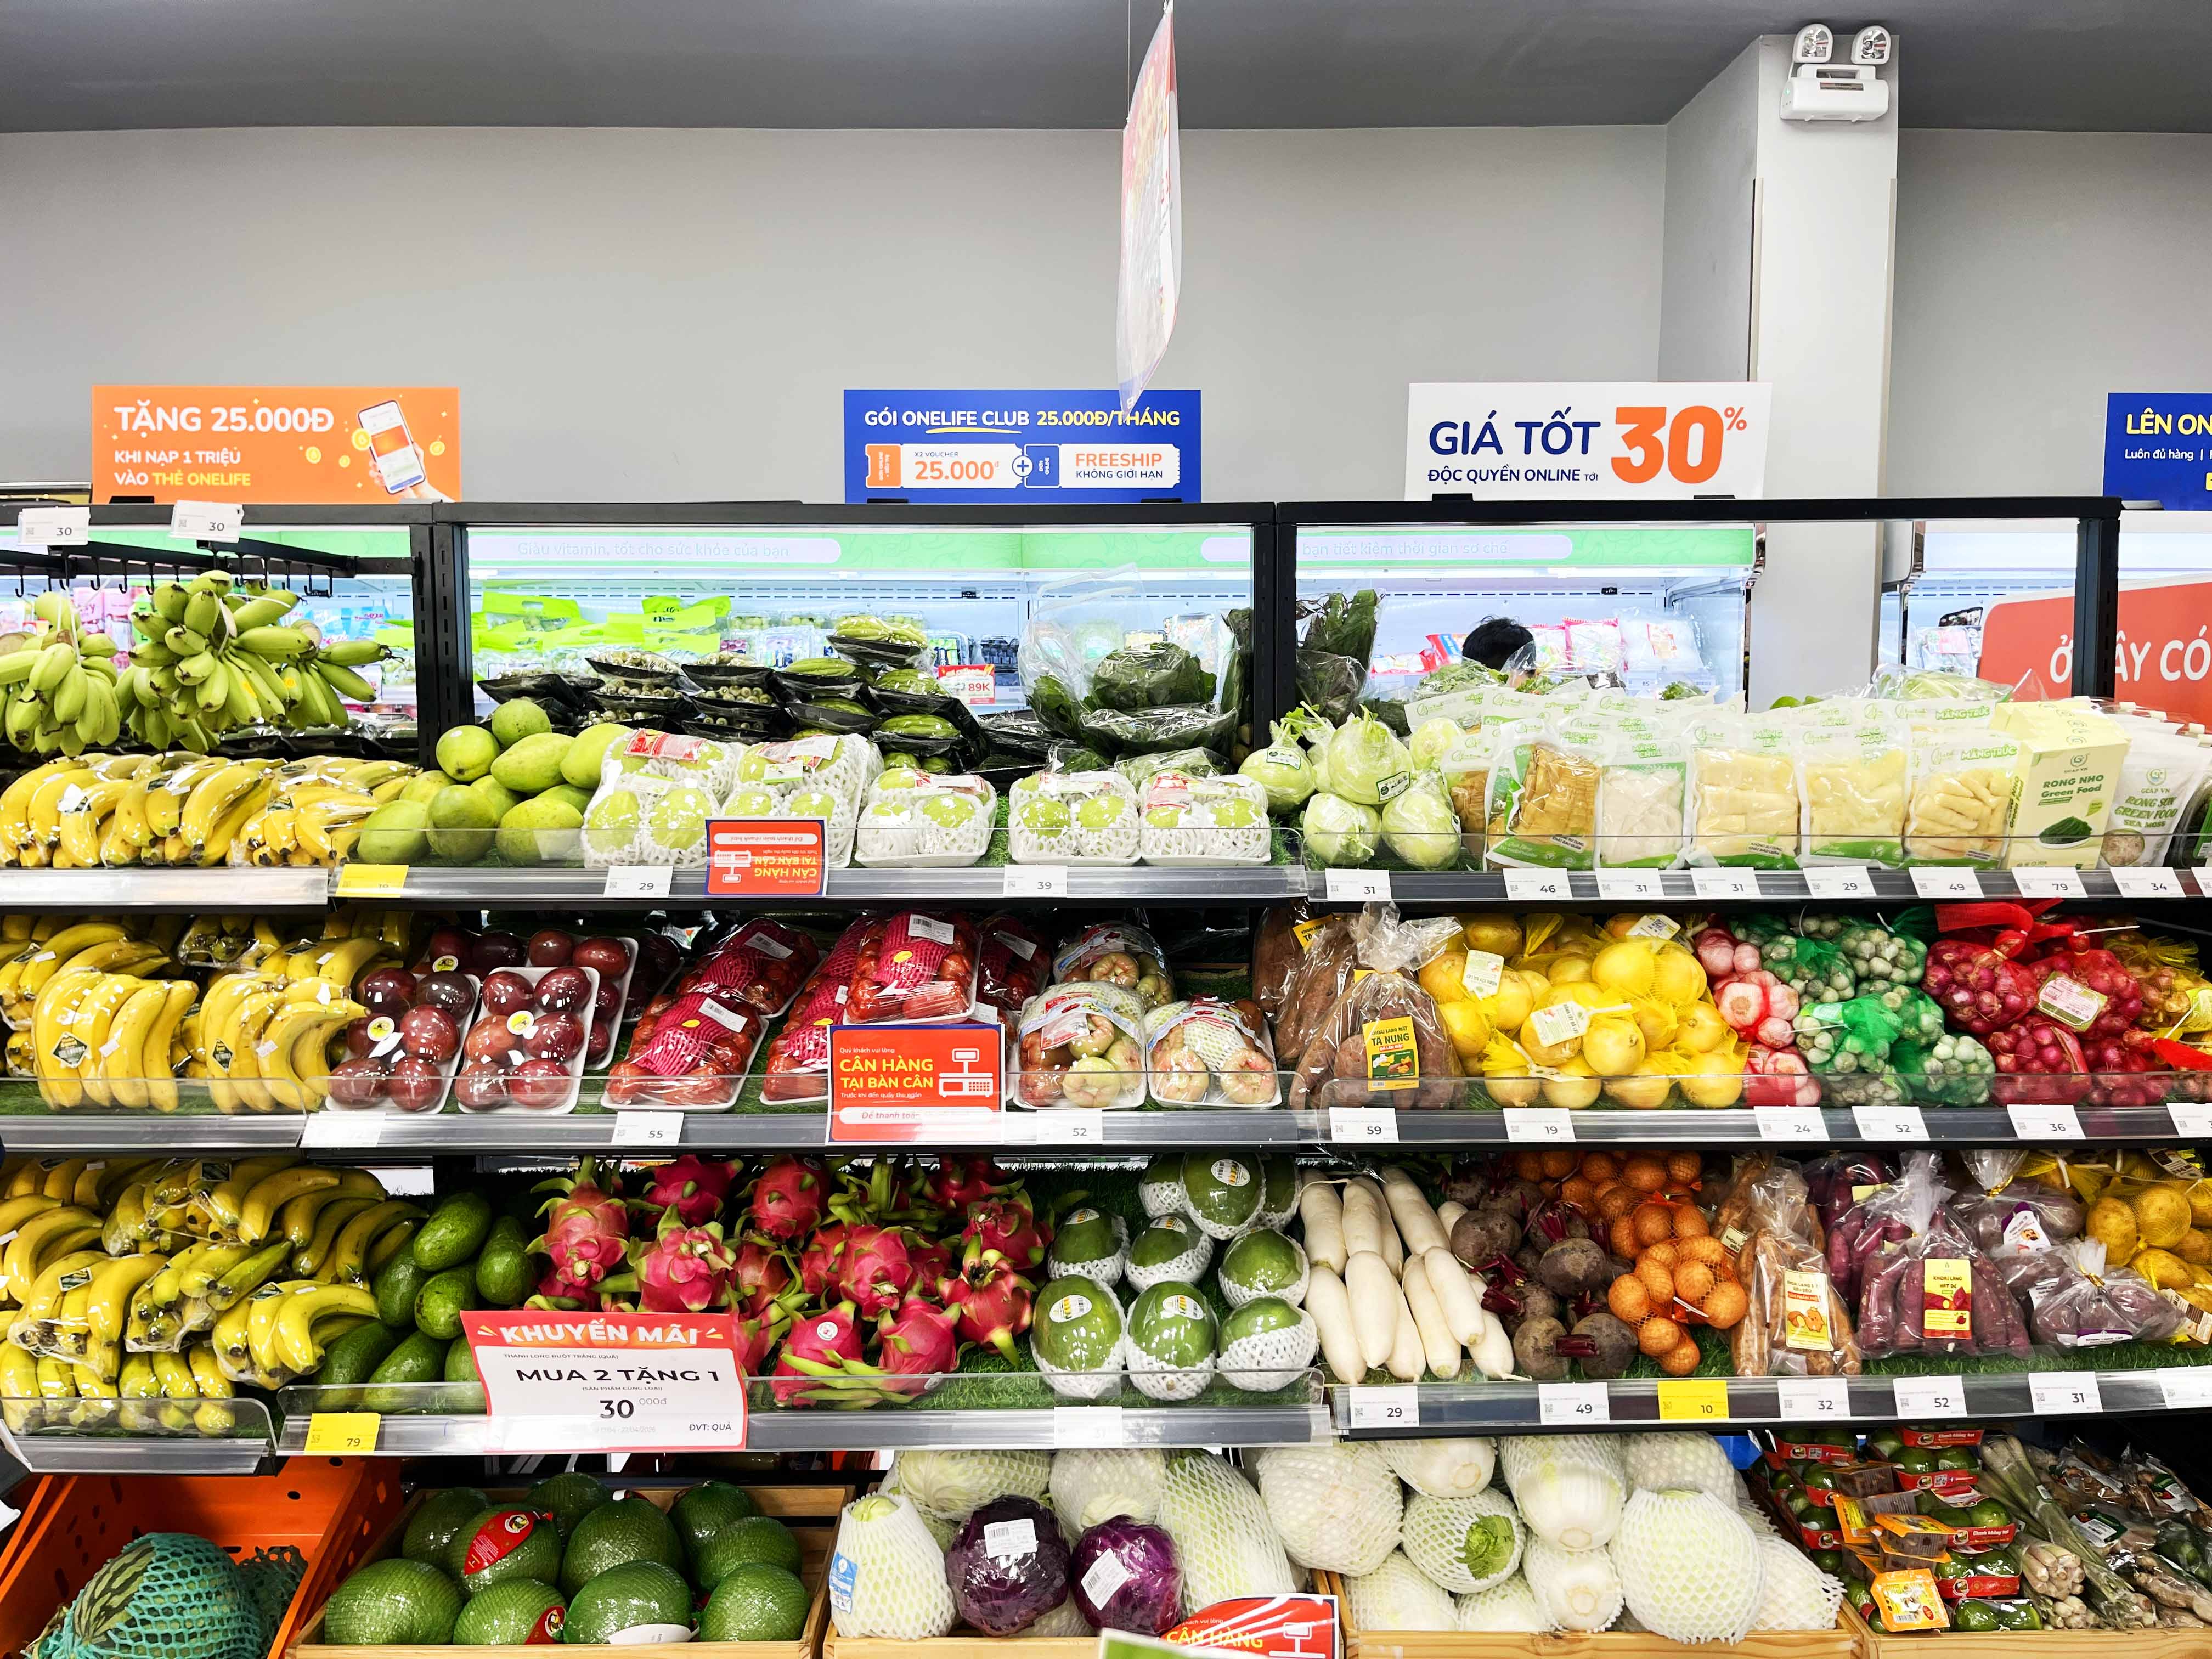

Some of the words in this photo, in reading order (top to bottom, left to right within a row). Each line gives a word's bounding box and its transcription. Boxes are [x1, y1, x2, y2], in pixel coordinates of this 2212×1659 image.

[114, 399, 201, 438] TẶNG
[211, 408, 334, 432] 25.000Đ
[865, 407, 898, 426] GÓI
[902, 410, 977, 427] ONELIFE
[982, 410, 1030, 426] CLUB
[2126, 408, 2172, 435] LÊN
[2177, 413, 2212, 435] ON
[1429, 410, 1503, 455] GIÁ
[1514, 406, 1601, 455] TỐT
[114, 450, 141, 464] KHI
[145, 450, 179, 466] NẠP
[183, 450, 192, 464] 1
[195, 447, 241, 465] TRIỆU
[2125, 449, 2151, 460] Luôn
[2153, 448, 2166, 460] đủ
[2168, 448, 2194, 461] hàng
[1075, 453, 1163, 468] FREESHIP
[114, 469, 149, 486] VÀO
[152, 469, 184, 486] THẺ
[187, 472, 251, 486] ONELIFE
[1076, 468, 1114, 479] KHÔNG
[1117, 468, 1146, 479] GIỚI
[1148, 470, 1164, 482] HẠN
[1427, 465, 1463, 485] ĐỘC
[1466, 464, 1520, 483] QUYỀN
[1524, 469, 1581, 482] ONLINE
[1584, 471, 1599, 482] TỚI
[57, 527, 72, 537] 30
[209, 522, 225, 532] 30
[517, 543, 549, 556] Giàu
[637, 543, 663, 555] cho
[668, 542, 691, 556] sức
[1360, 542, 1392, 557] kiệm
[1429, 543, 1458, 557] gian
[2115, 629, 2151, 683] ÂY
[2159, 625, 2212, 682] CÓ
[968, 682, 990, 692] 89K
[2043, 778, 2076, 789] RONG
[2079, 774, 2104, 785] NHO
[2041, 789, 2074, 799] Green
[2076, 783, 2103, 794] Food
[2155, 808, 2178, 819] FOOD
[777, 856, 799, 867] BÀN
[802, 855, 817, 865] TẠI
[754, 868, 789, 879] HÀNG
[792, 868, 817, 879] CÂN
[639, 882, 654, 891] 29
[1037, 881, 1052, 890] 39
[1363, 886, 1375, 894] 31
[1540, 884, 1556, 893] 46
[1635, 884, 1649, 893] 31
[1731, 883, 1744, 892] 31
[1842, 882, 1858, 891] 29
[1949, 883, 1965, 891] 49
[2150, 883, 2168, 891] 34
[1385, 1033, 1409, 1044] NUNG
[840, 1055, 878, 1073] CÂN
[882, 1054, 934, 1072] HÀNG
[840, 1077, 864, 1091] TẠI
[868, 1074, 899, 1088] BÀN
[903, 1074, 934, 1088] CÂN
[1073, 1128, 1087, 1136] 52
[1366, 1126, 1382, 1135] 59
[1544, 1126, 1558, 1135] 19
[1794, 1124, 1811, 1133] 24
[1895, 1124, 1911, 1133] 52
[2049, 1124, 2066, 1132] 36
[500, 1318, 629, 1344] KHUYẾN
[639, 1323, 698, 1345] MÃI
[516, 1369, 588, 1381] MUA
[593, 1369, 612, 1381] 2
[617, 1366, 702, 1385] TẶNG
[707, 1370, 720, 1381] 1
[1934, 1397, 1950, 1408] 52
[2071, 1393, 2085, 1403] 31
[600, 1399, 635, 1419] 30
[1576, 1404, 1593, 1414] 49
[1701, 1405, 1713, 1414] 10
[1818, 1401, 1833, 1410] 32
[1386, 1407, 1402, 1418] 29
[689, 1423, 710, 1431] ĐVT:
[712, 1422, 732, 1431] QUẢ
[346, 1438, 361, 1447] 79
